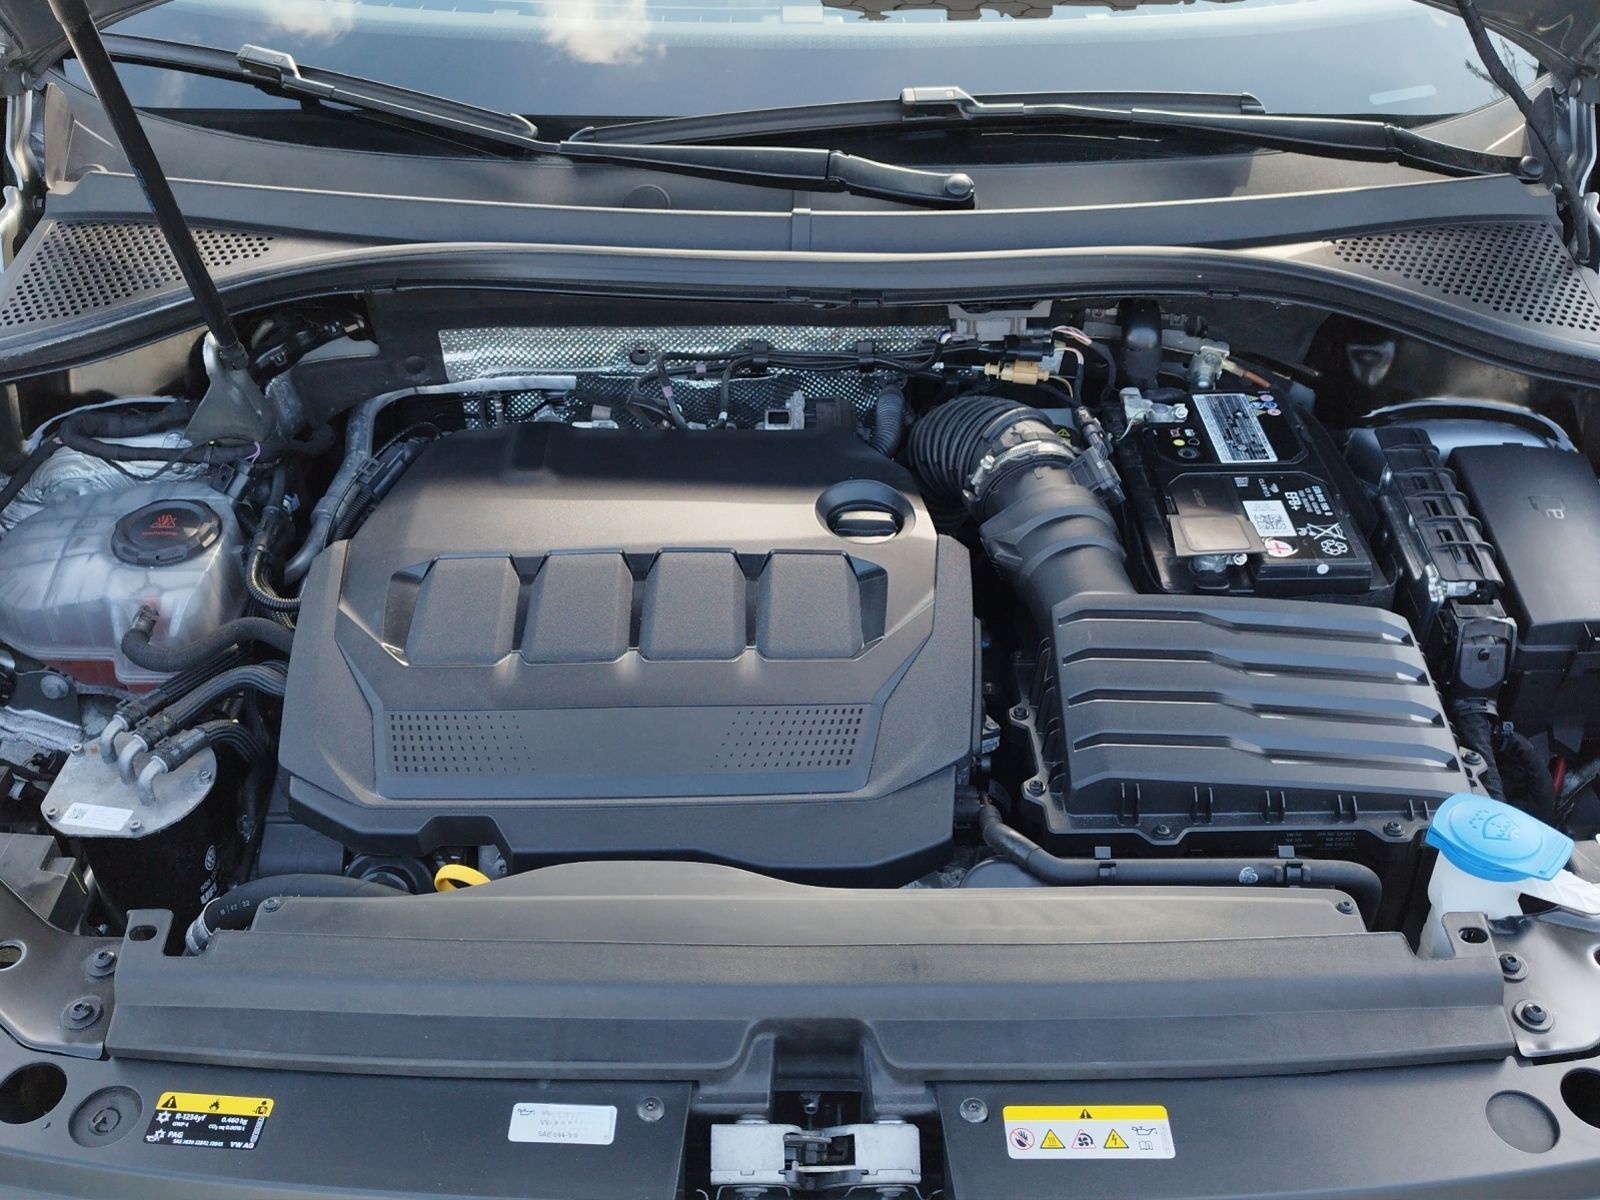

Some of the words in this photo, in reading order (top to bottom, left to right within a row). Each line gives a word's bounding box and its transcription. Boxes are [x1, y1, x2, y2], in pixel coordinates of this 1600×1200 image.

[1285, 491, 1302, 511] EFB+
[175, 1113, 207, 1122] R-1234yf
[221, 1116, 239, 1124] 0.460
